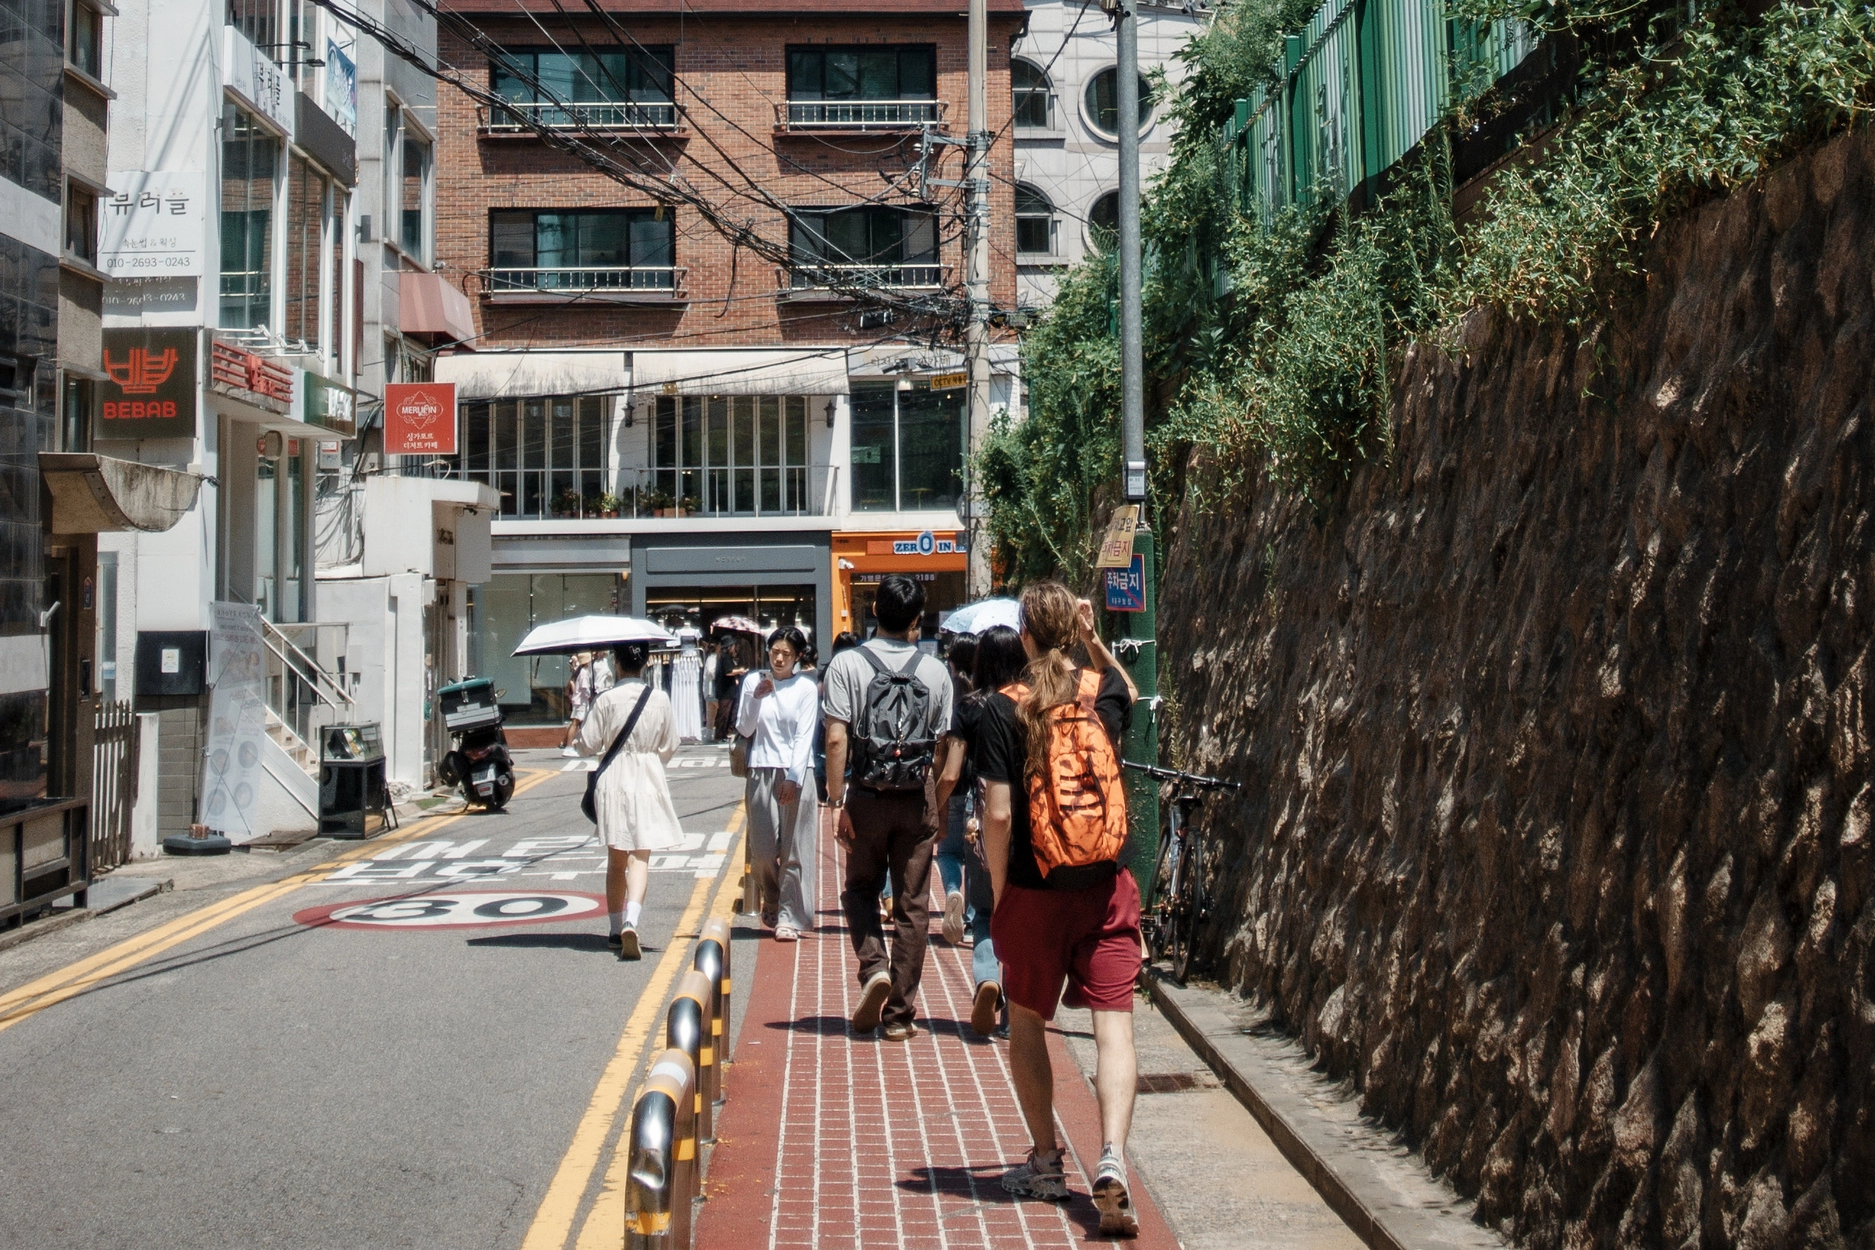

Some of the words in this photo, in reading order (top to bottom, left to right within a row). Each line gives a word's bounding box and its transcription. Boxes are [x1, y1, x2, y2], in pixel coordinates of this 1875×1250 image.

[106, 256, 191, 268] 010-2693-0243
[933, 377, 952, 387] CCTV
[103, 401, 177, 419] BEBAB
[937, 540, 952, 552] IN
[860, 574, 886, 582] 가맹문
[1107, 571, 1140, 591] 주차금지
[345, 896, 570, 920] 30
